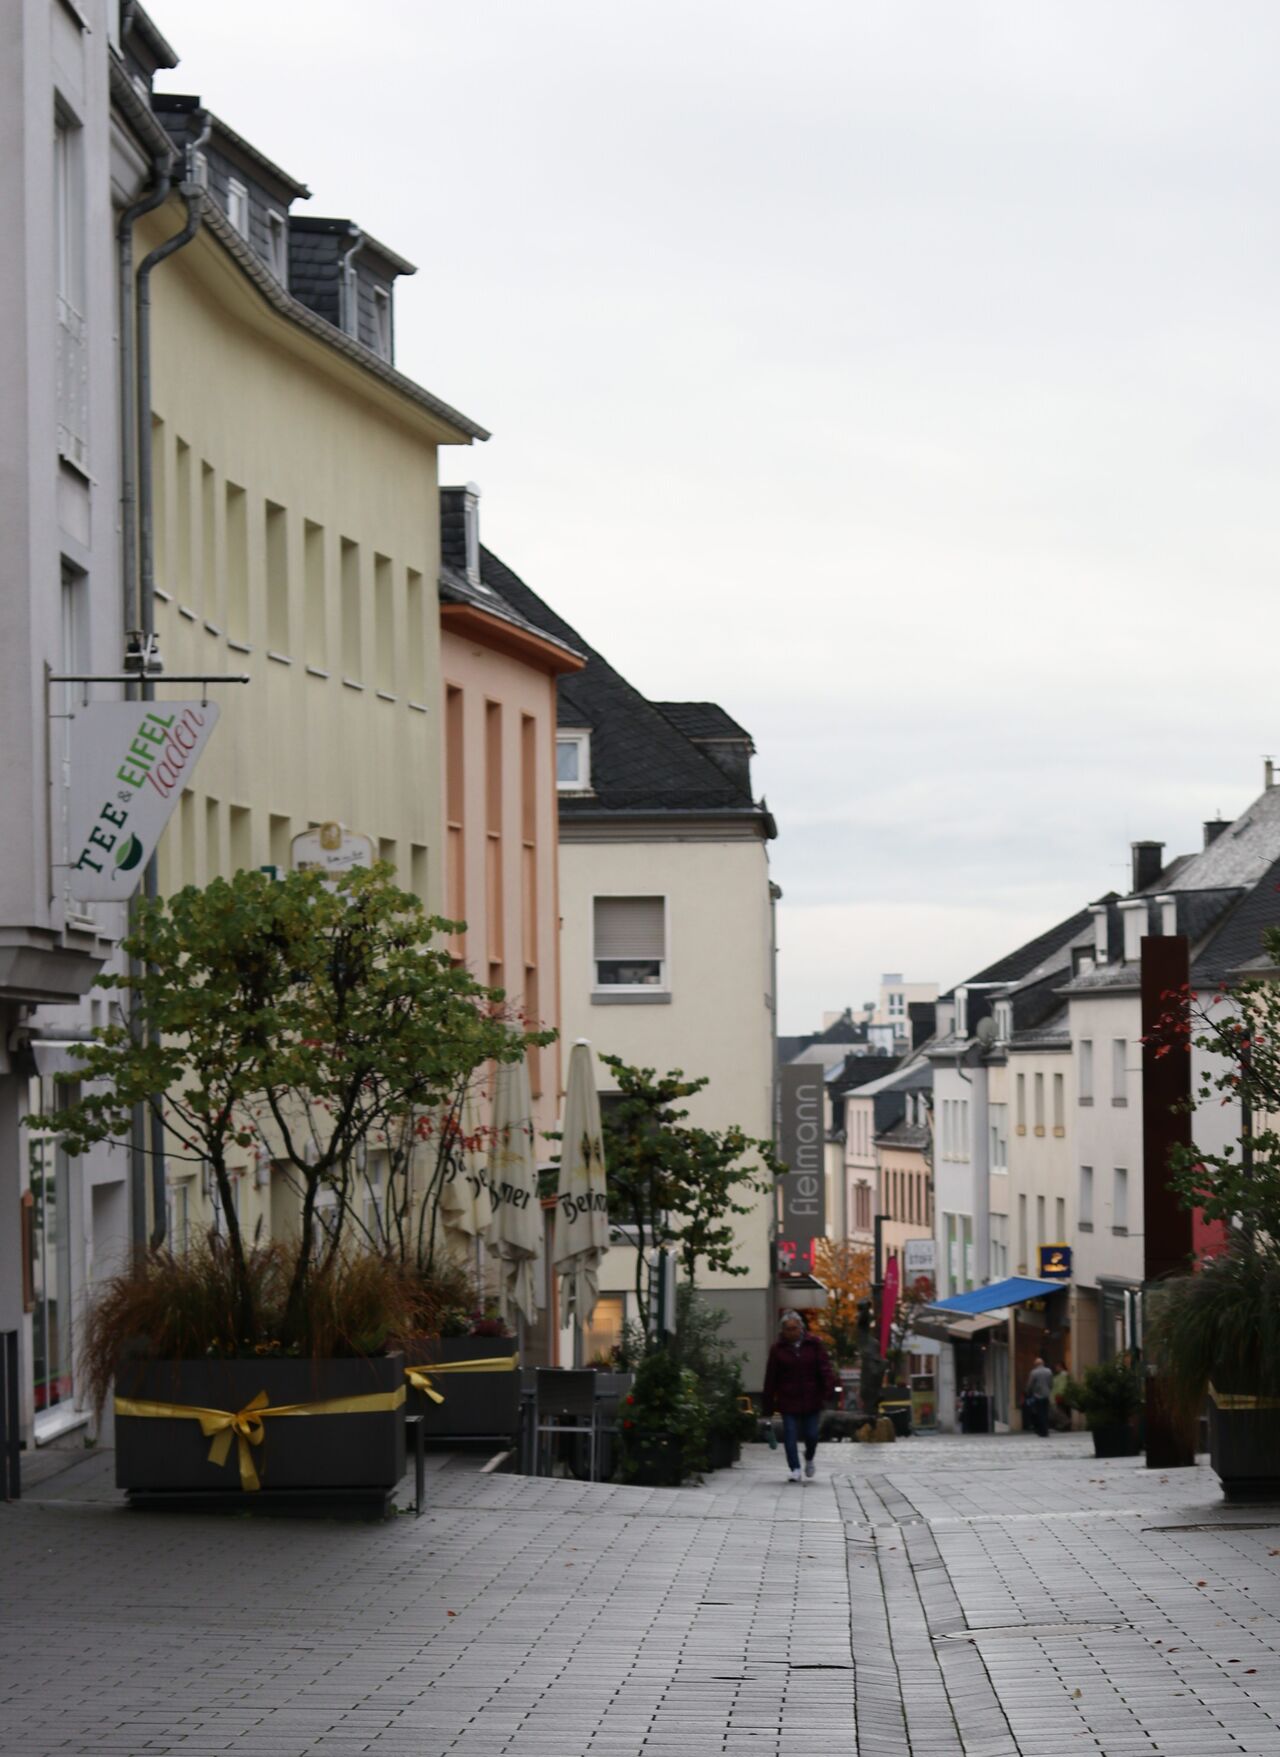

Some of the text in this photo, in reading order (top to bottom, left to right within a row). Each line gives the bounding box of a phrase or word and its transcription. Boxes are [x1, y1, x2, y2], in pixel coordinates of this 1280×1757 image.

[75, 713, 176, 873] TEE & EIFEL
[145, 708, 205, 799] laden
[789, 1084, 819, 1216] fielmann
